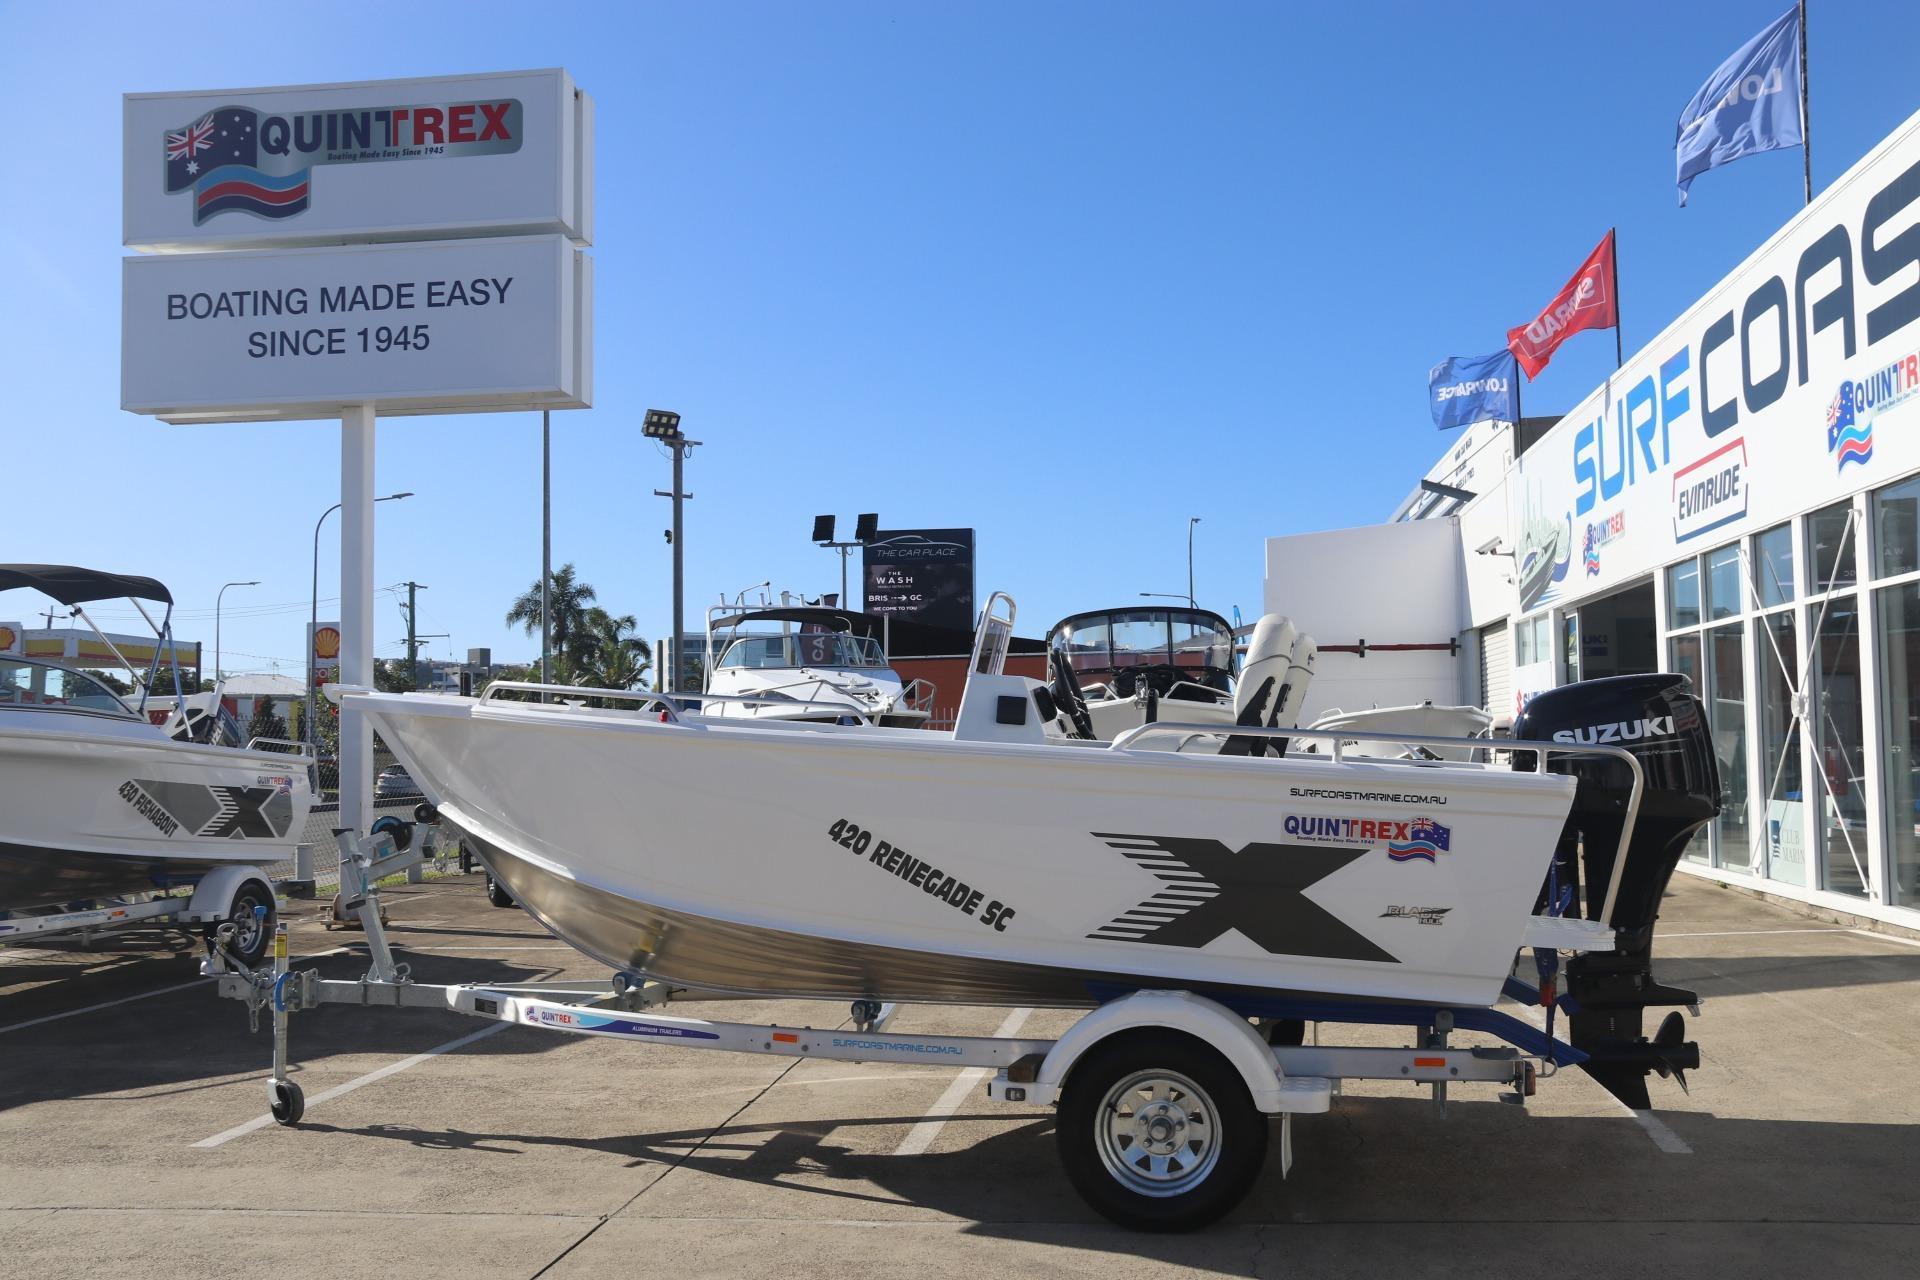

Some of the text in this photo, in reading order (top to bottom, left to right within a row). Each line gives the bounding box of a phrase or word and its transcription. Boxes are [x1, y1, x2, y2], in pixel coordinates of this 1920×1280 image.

[260, 103, 512, 155] QUINTREX
[328, 152, 357, 161] Boating
[382, 150, 400, 158] Easy
[402, 148, 421, 156] Since
[424, 146, 444, 155] 1945
[166, 276, 514, 320] BOATING MADE EASY
[247, 324, 430, 358] SINCE 1945
[1855, 351, 1920, 414] QUINTR
[1678, 463, 1740, 521] EVINRUDE
[1592, 511, 1625, 545] QUINTREX
[877, 547, 957, 557] THE CAR PLACE
[876, 576, 913, 584] WASH
[868, 594, 888, 602] BRIS
[1552, 715, 1675, 744] SUZUKI
[118, 780, 179, 838] 430 FISHABOUT
[1290, 787, 1447, 805] SURFCOASTMARINE.COM.AU
[1284, 815, 1409, 841] QUINTREX
[1782, 846, 1805, 865] MARIN
[828, 818, 1016, 932] 420 RENEGADE SC
[541, 1011, 572, 1025] QUINTREX
[832, 1038, 963, 1055] SURFCOASTMARINE.COM.AU
